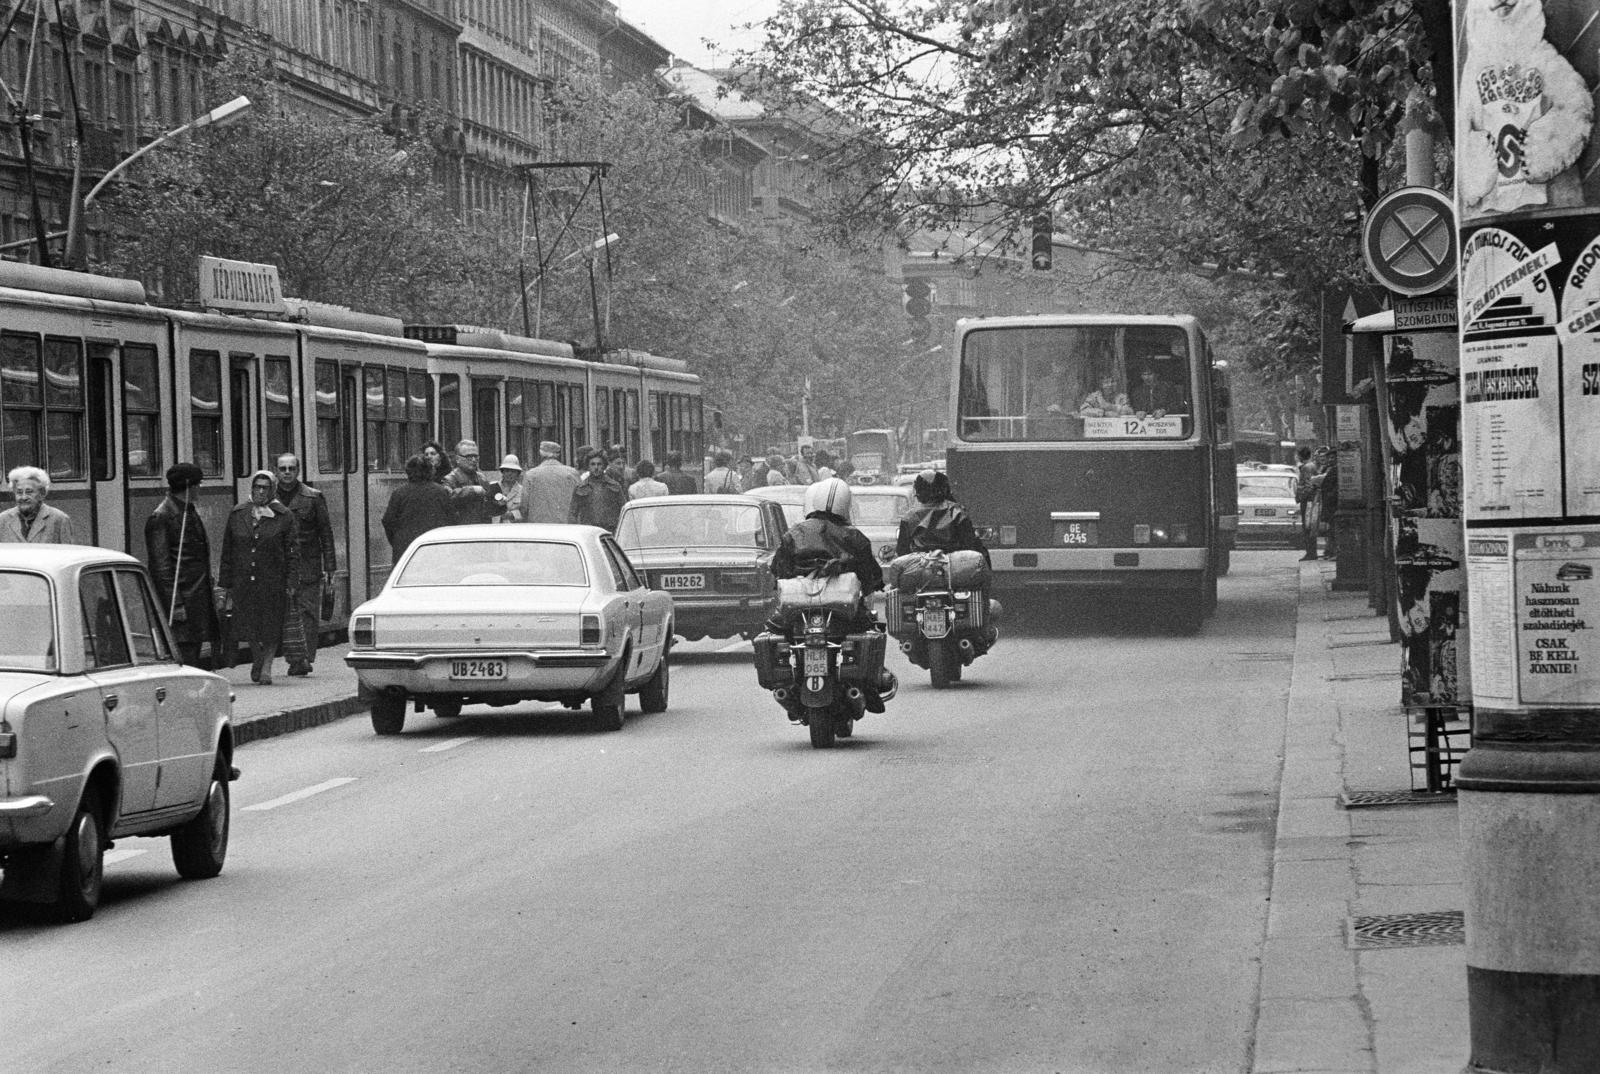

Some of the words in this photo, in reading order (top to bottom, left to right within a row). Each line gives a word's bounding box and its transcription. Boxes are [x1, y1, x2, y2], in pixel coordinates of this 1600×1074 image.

[1397, 313, 1456, 327] SZOMBATON
[1069, 523, 1081, 533] GE
[1063, 533, 1087, 543] 0245
[1531, 583, 1570, 593] Nálunk
[1525, 596, 1580, 606] hasznosan
[1529, 650, 1543, 660] BE
[1547, 650, 1580, 660] KELL
